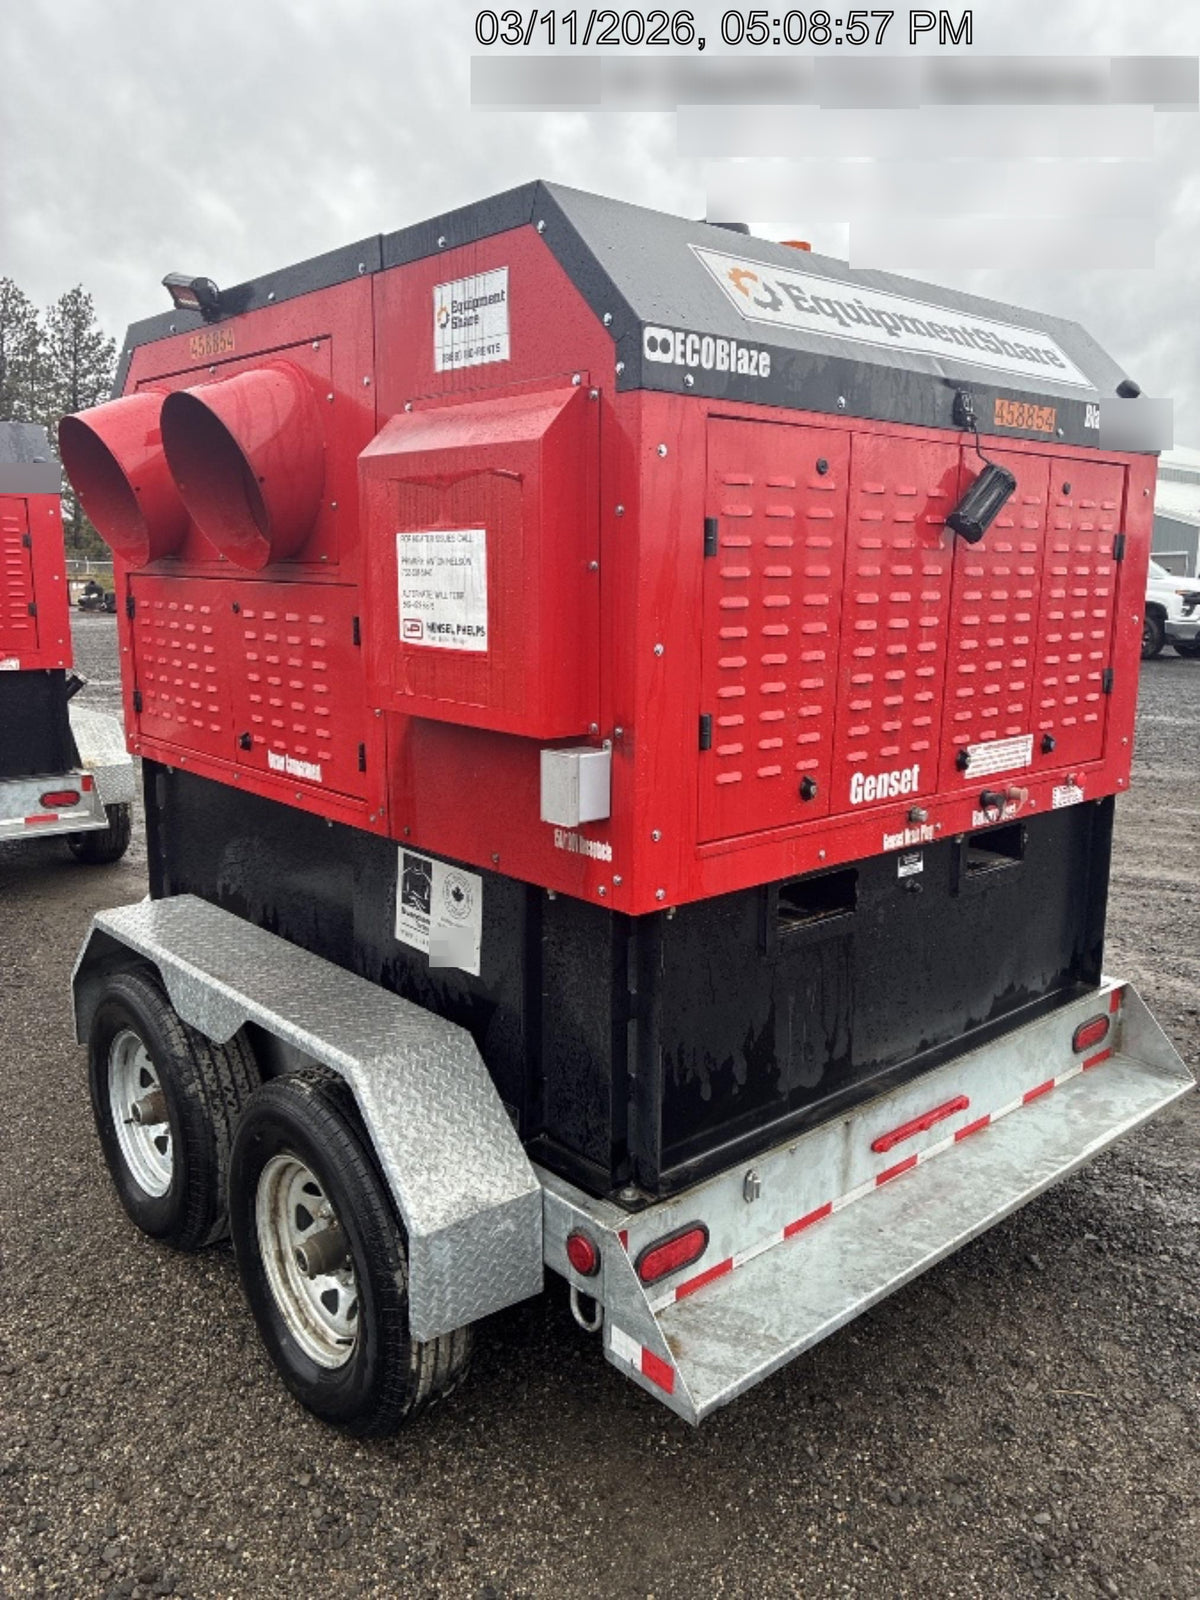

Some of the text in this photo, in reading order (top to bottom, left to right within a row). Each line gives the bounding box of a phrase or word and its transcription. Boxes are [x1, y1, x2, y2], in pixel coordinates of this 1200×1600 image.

[451, 289, 505, 315] Equipment
[775, 280, 1066, 369] EquipmentShare
[674, 331, 771, 378] ECOBlaze
[994, 400, 1055, 431] 458854
[849, 763, 920, 805] Genset
